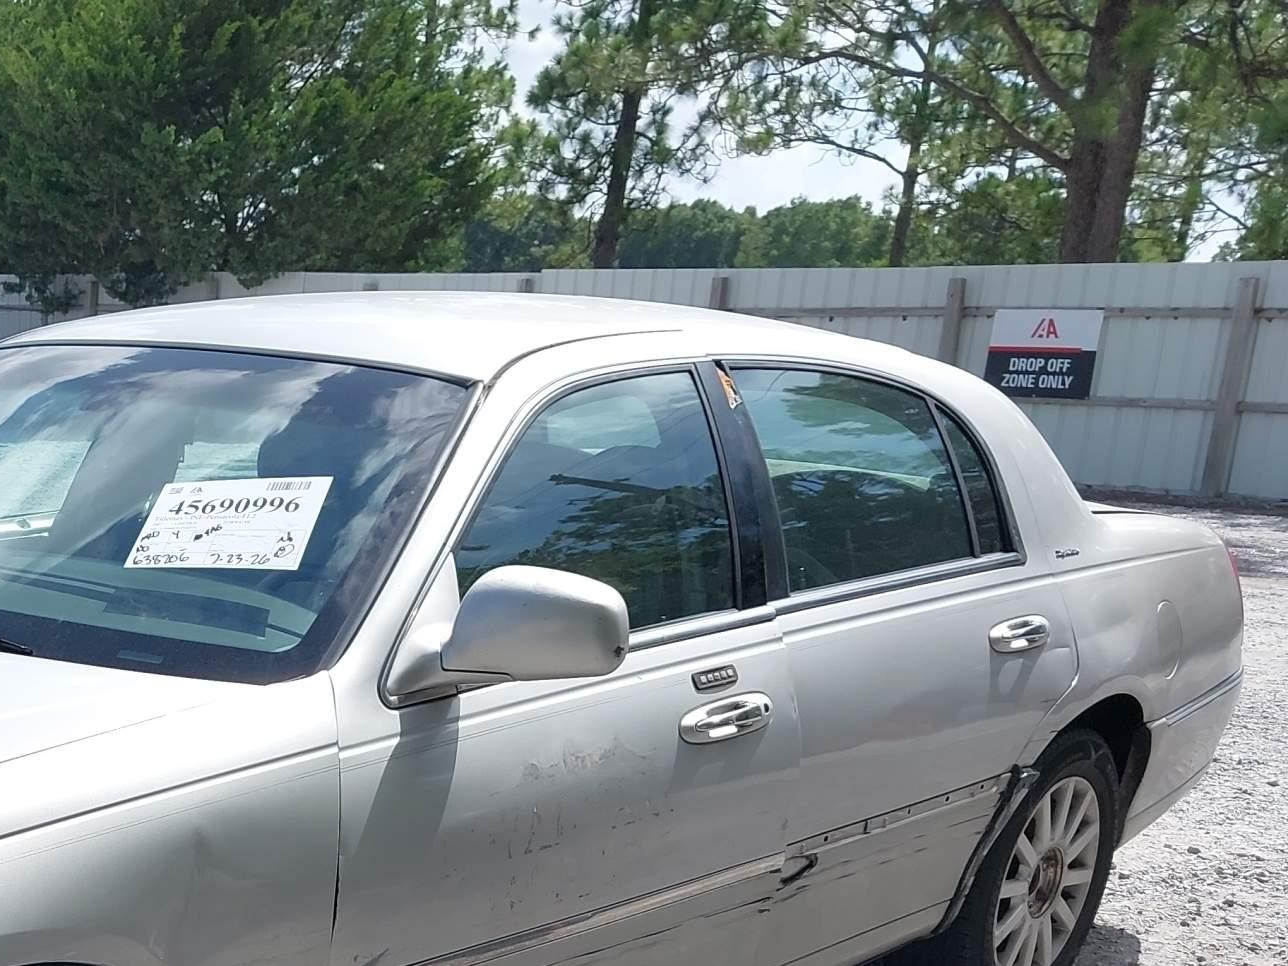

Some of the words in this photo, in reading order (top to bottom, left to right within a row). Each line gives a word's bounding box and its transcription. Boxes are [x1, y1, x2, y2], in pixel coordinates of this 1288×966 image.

[1009, 357, 1045, 371] DROP
[1047, 358, 1072, 373] OFF
[1000, 373, 1037, 388] ZONE
[1038, 374, 1074, 389] ONLY
[168, 495, 303, 516] 45690996
